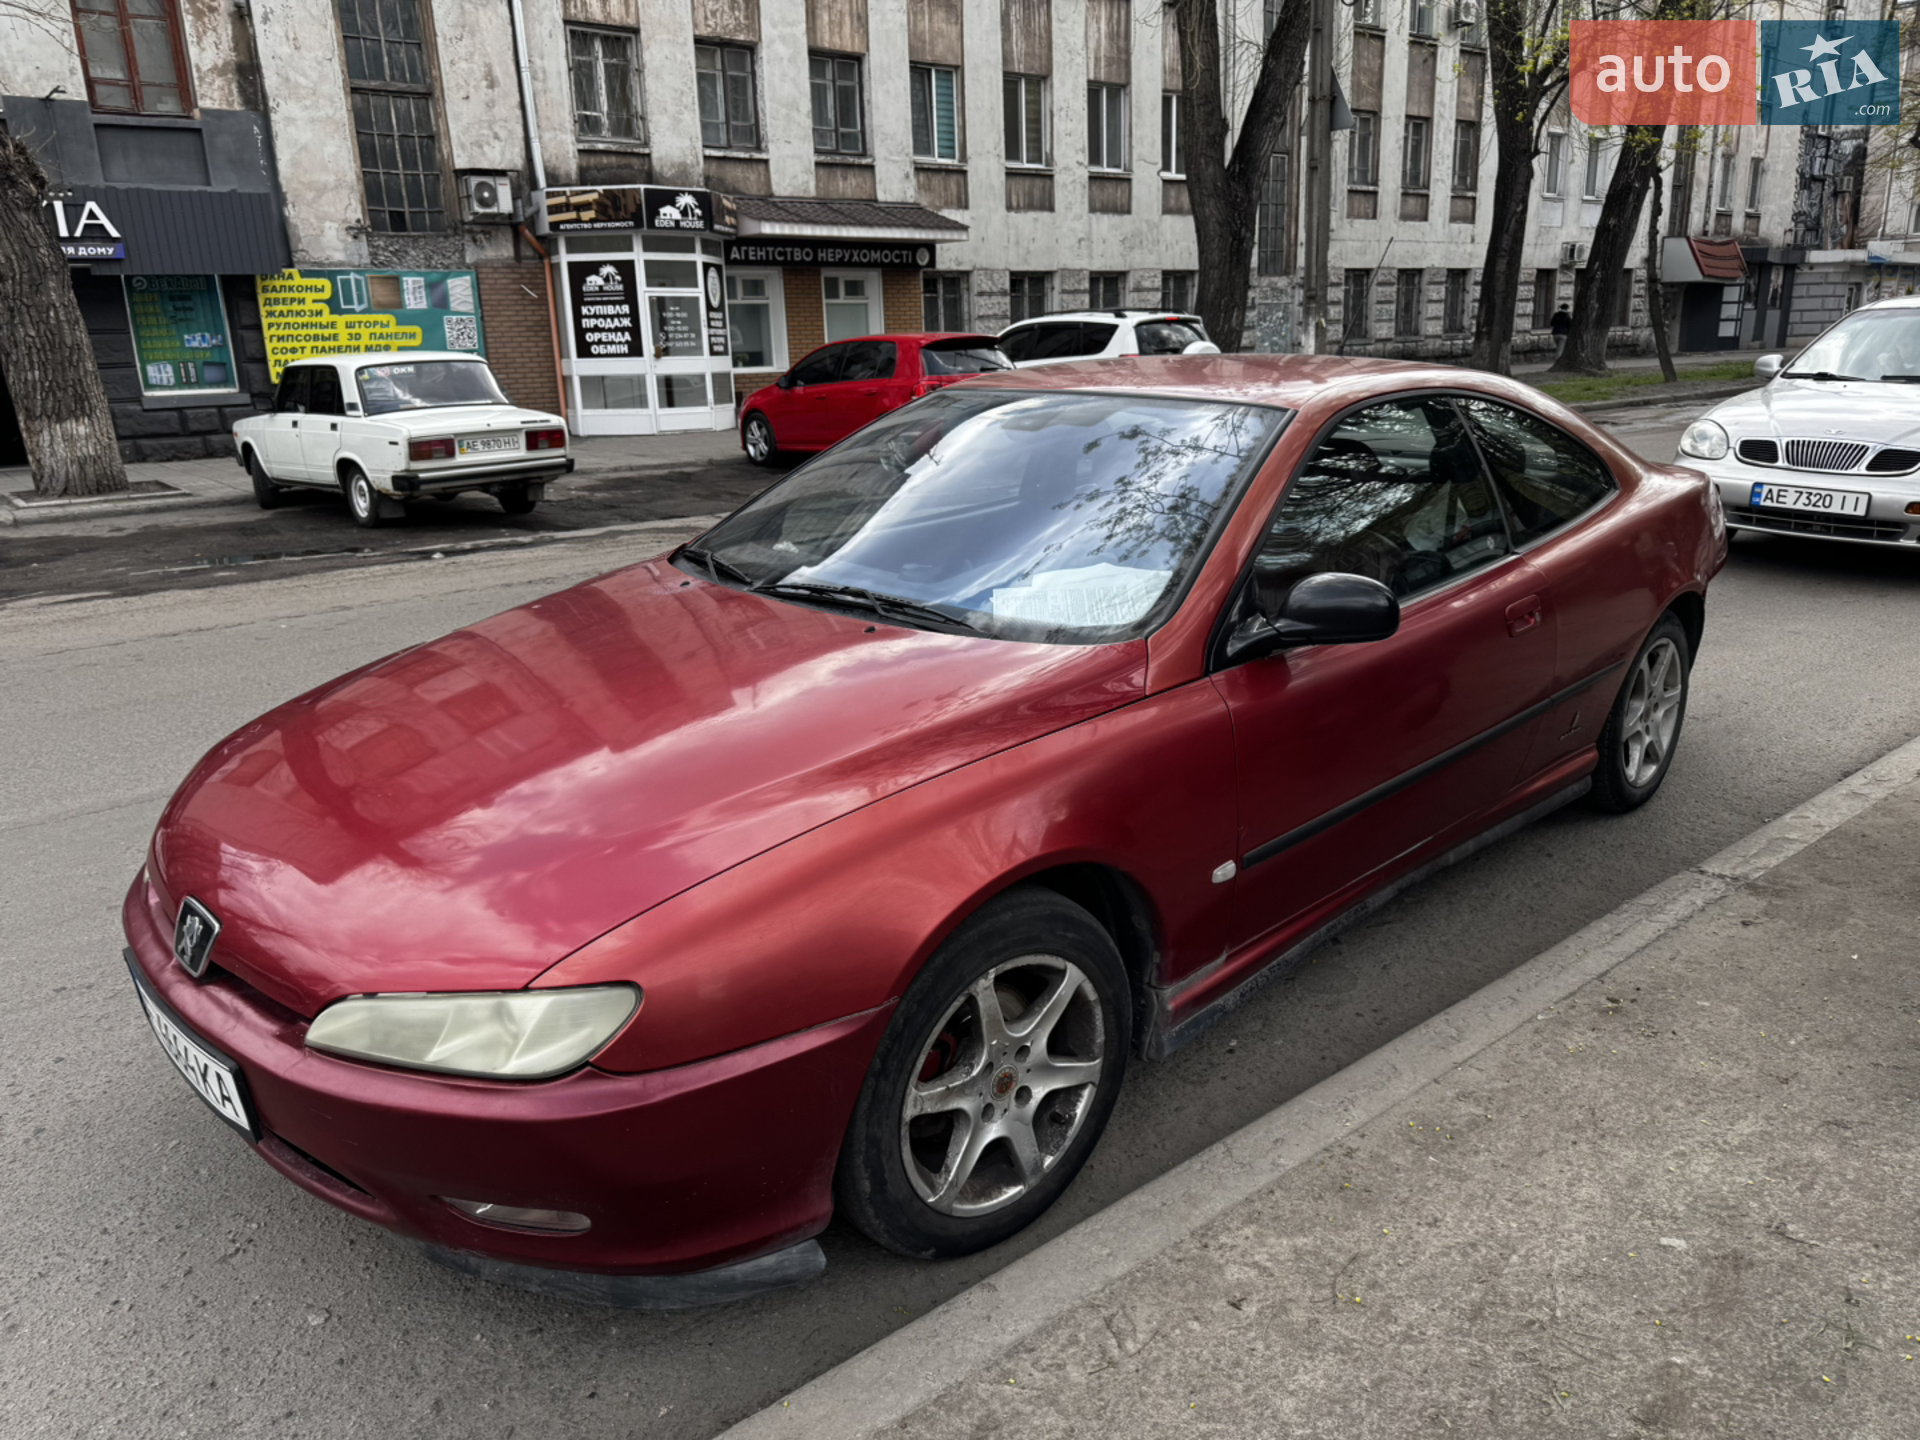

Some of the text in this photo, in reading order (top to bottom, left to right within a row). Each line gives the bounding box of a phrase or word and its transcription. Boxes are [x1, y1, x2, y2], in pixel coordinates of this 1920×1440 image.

[559, 221, 634, 230] АГЕНТСТВО НЕРУХОМОСТІ
[655, 219, 675, 228] EDEN
[680, 220, 704, 229] HOUSE
[78, 246, 114, 256] ДОМУ
[730, 246, 912, 264] АГЕНТСТВО НЕРУХОМОСТІ
[261, 285, 325, 294] БАЛКОНЫ
[582, 283, 624, 292] EDEN HOUSE
[263, 297, 306, 307] ДВЕРИ
[265, 309, 323, 319] ЖАЛЮЗИ
[581, 304, 630, 316] КУПІВЛЯ
[267, 320, 390, 331] РУЛОННЫЕ ШТОРЫ
[581, 317, 632, 329] ПРОДАЖ
[269, 331, 417, 343] ГИПСОВЫЕ 3D ПАНЕЛИ
[585, 331, 632, 343] ОРЕНДА
[271, 344, 392, 355] СОФТ ПАНЕЛИ МДФ
[590, 344, 629, 355] ОБМІН
[466, 441, 480, 452] AE
[480, 439, 502, 451] 9870
[1763, 488, 1788, 505] AE
[1792, 490, 1833, 509] 7320
